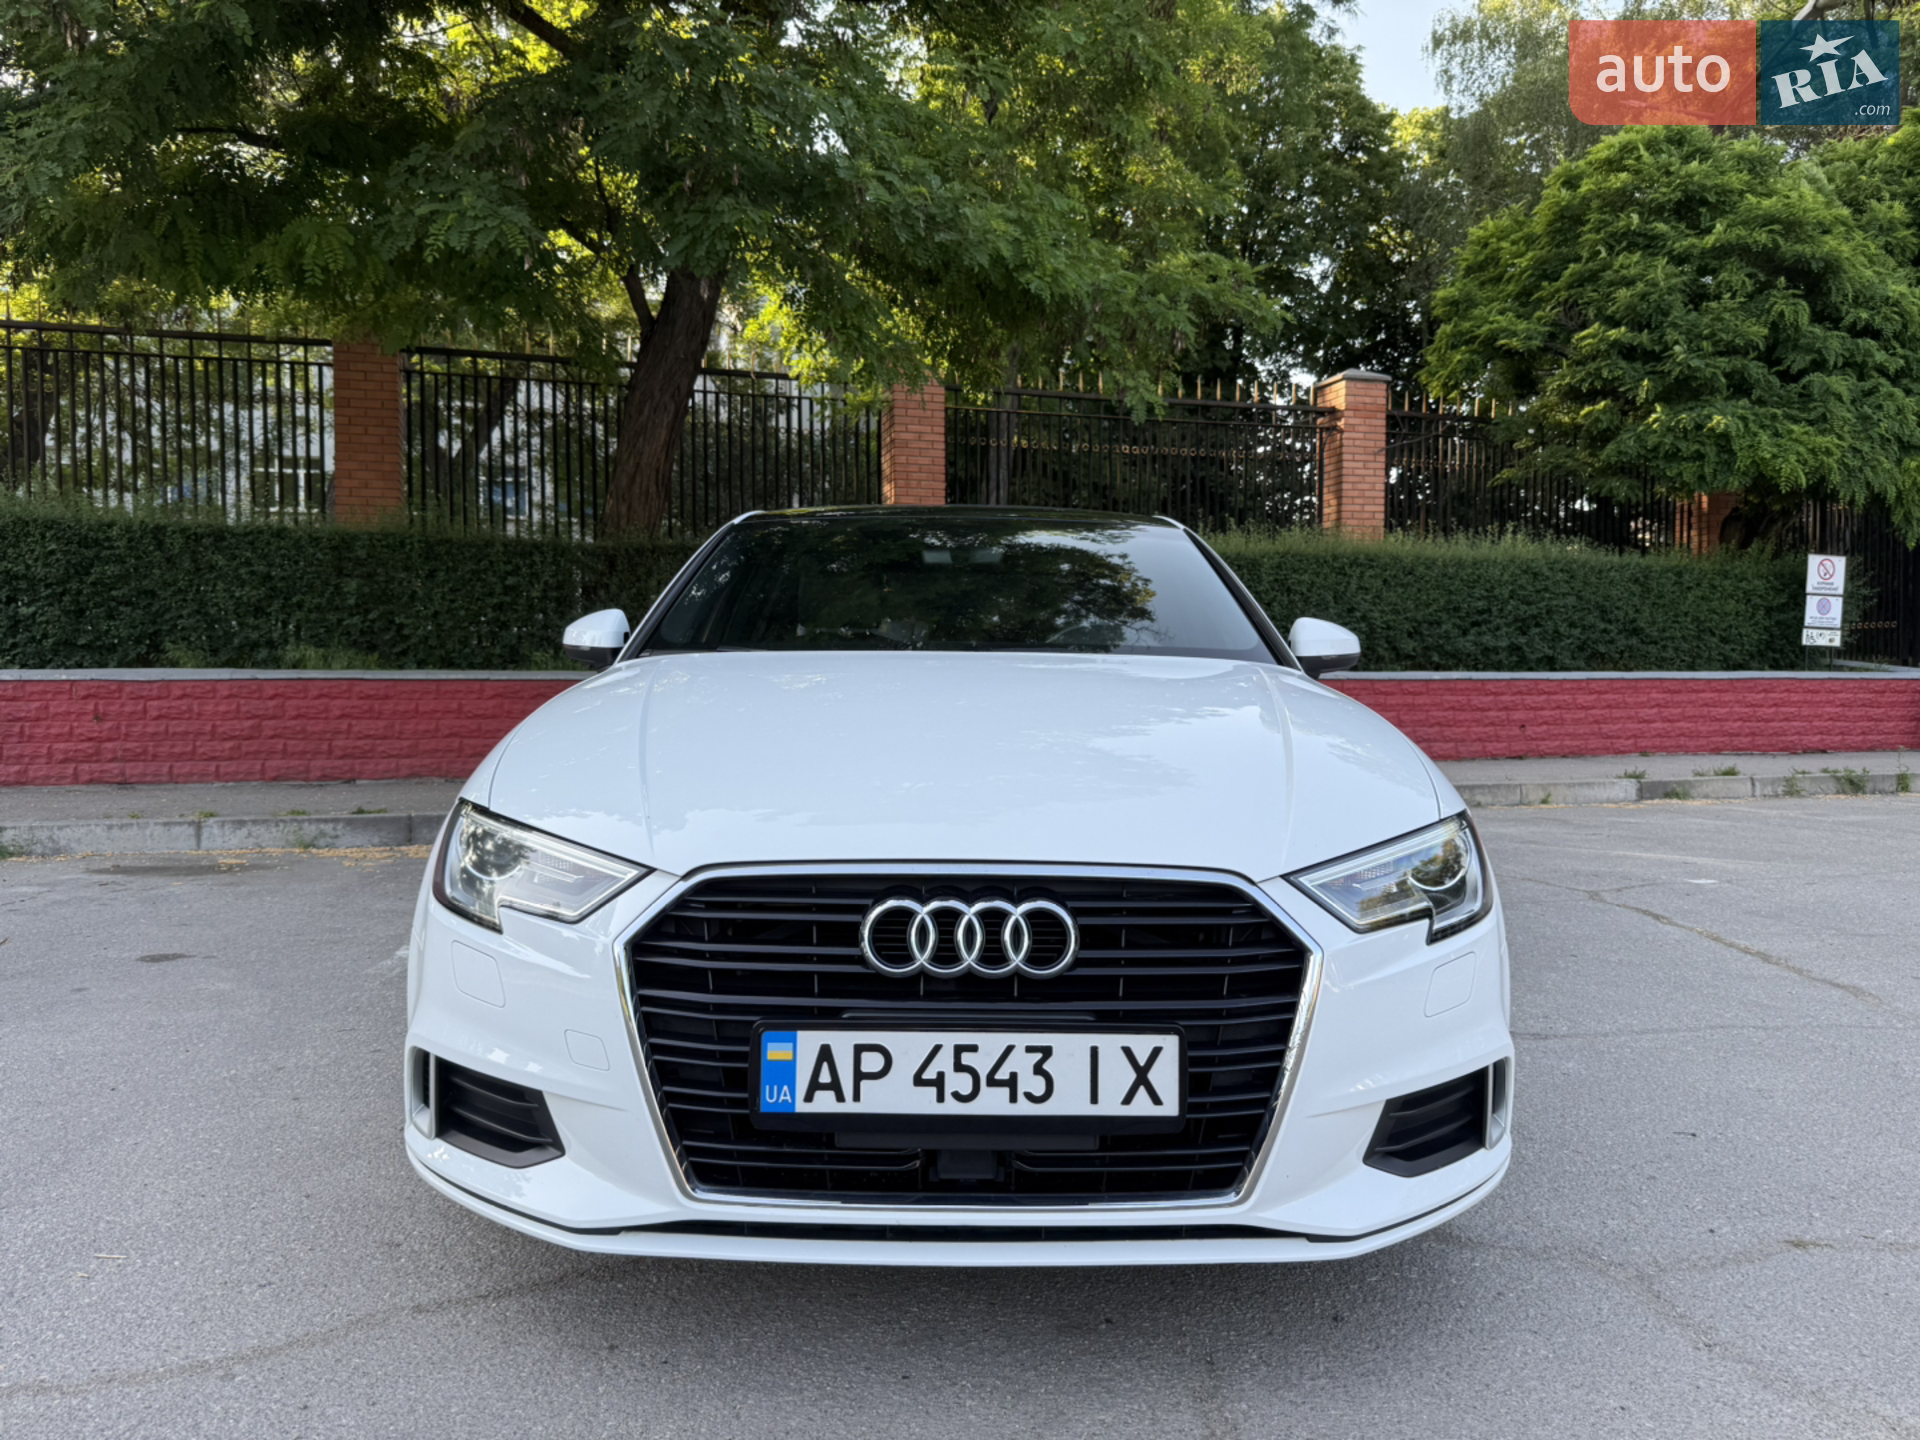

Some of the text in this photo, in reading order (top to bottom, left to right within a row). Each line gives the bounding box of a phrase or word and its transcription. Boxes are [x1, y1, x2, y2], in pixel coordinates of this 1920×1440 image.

[803, 1043, 893, 1104] AP
[912, 1043, 1055, 1105] 4543
[765, 1085, 792, 1104] UA
